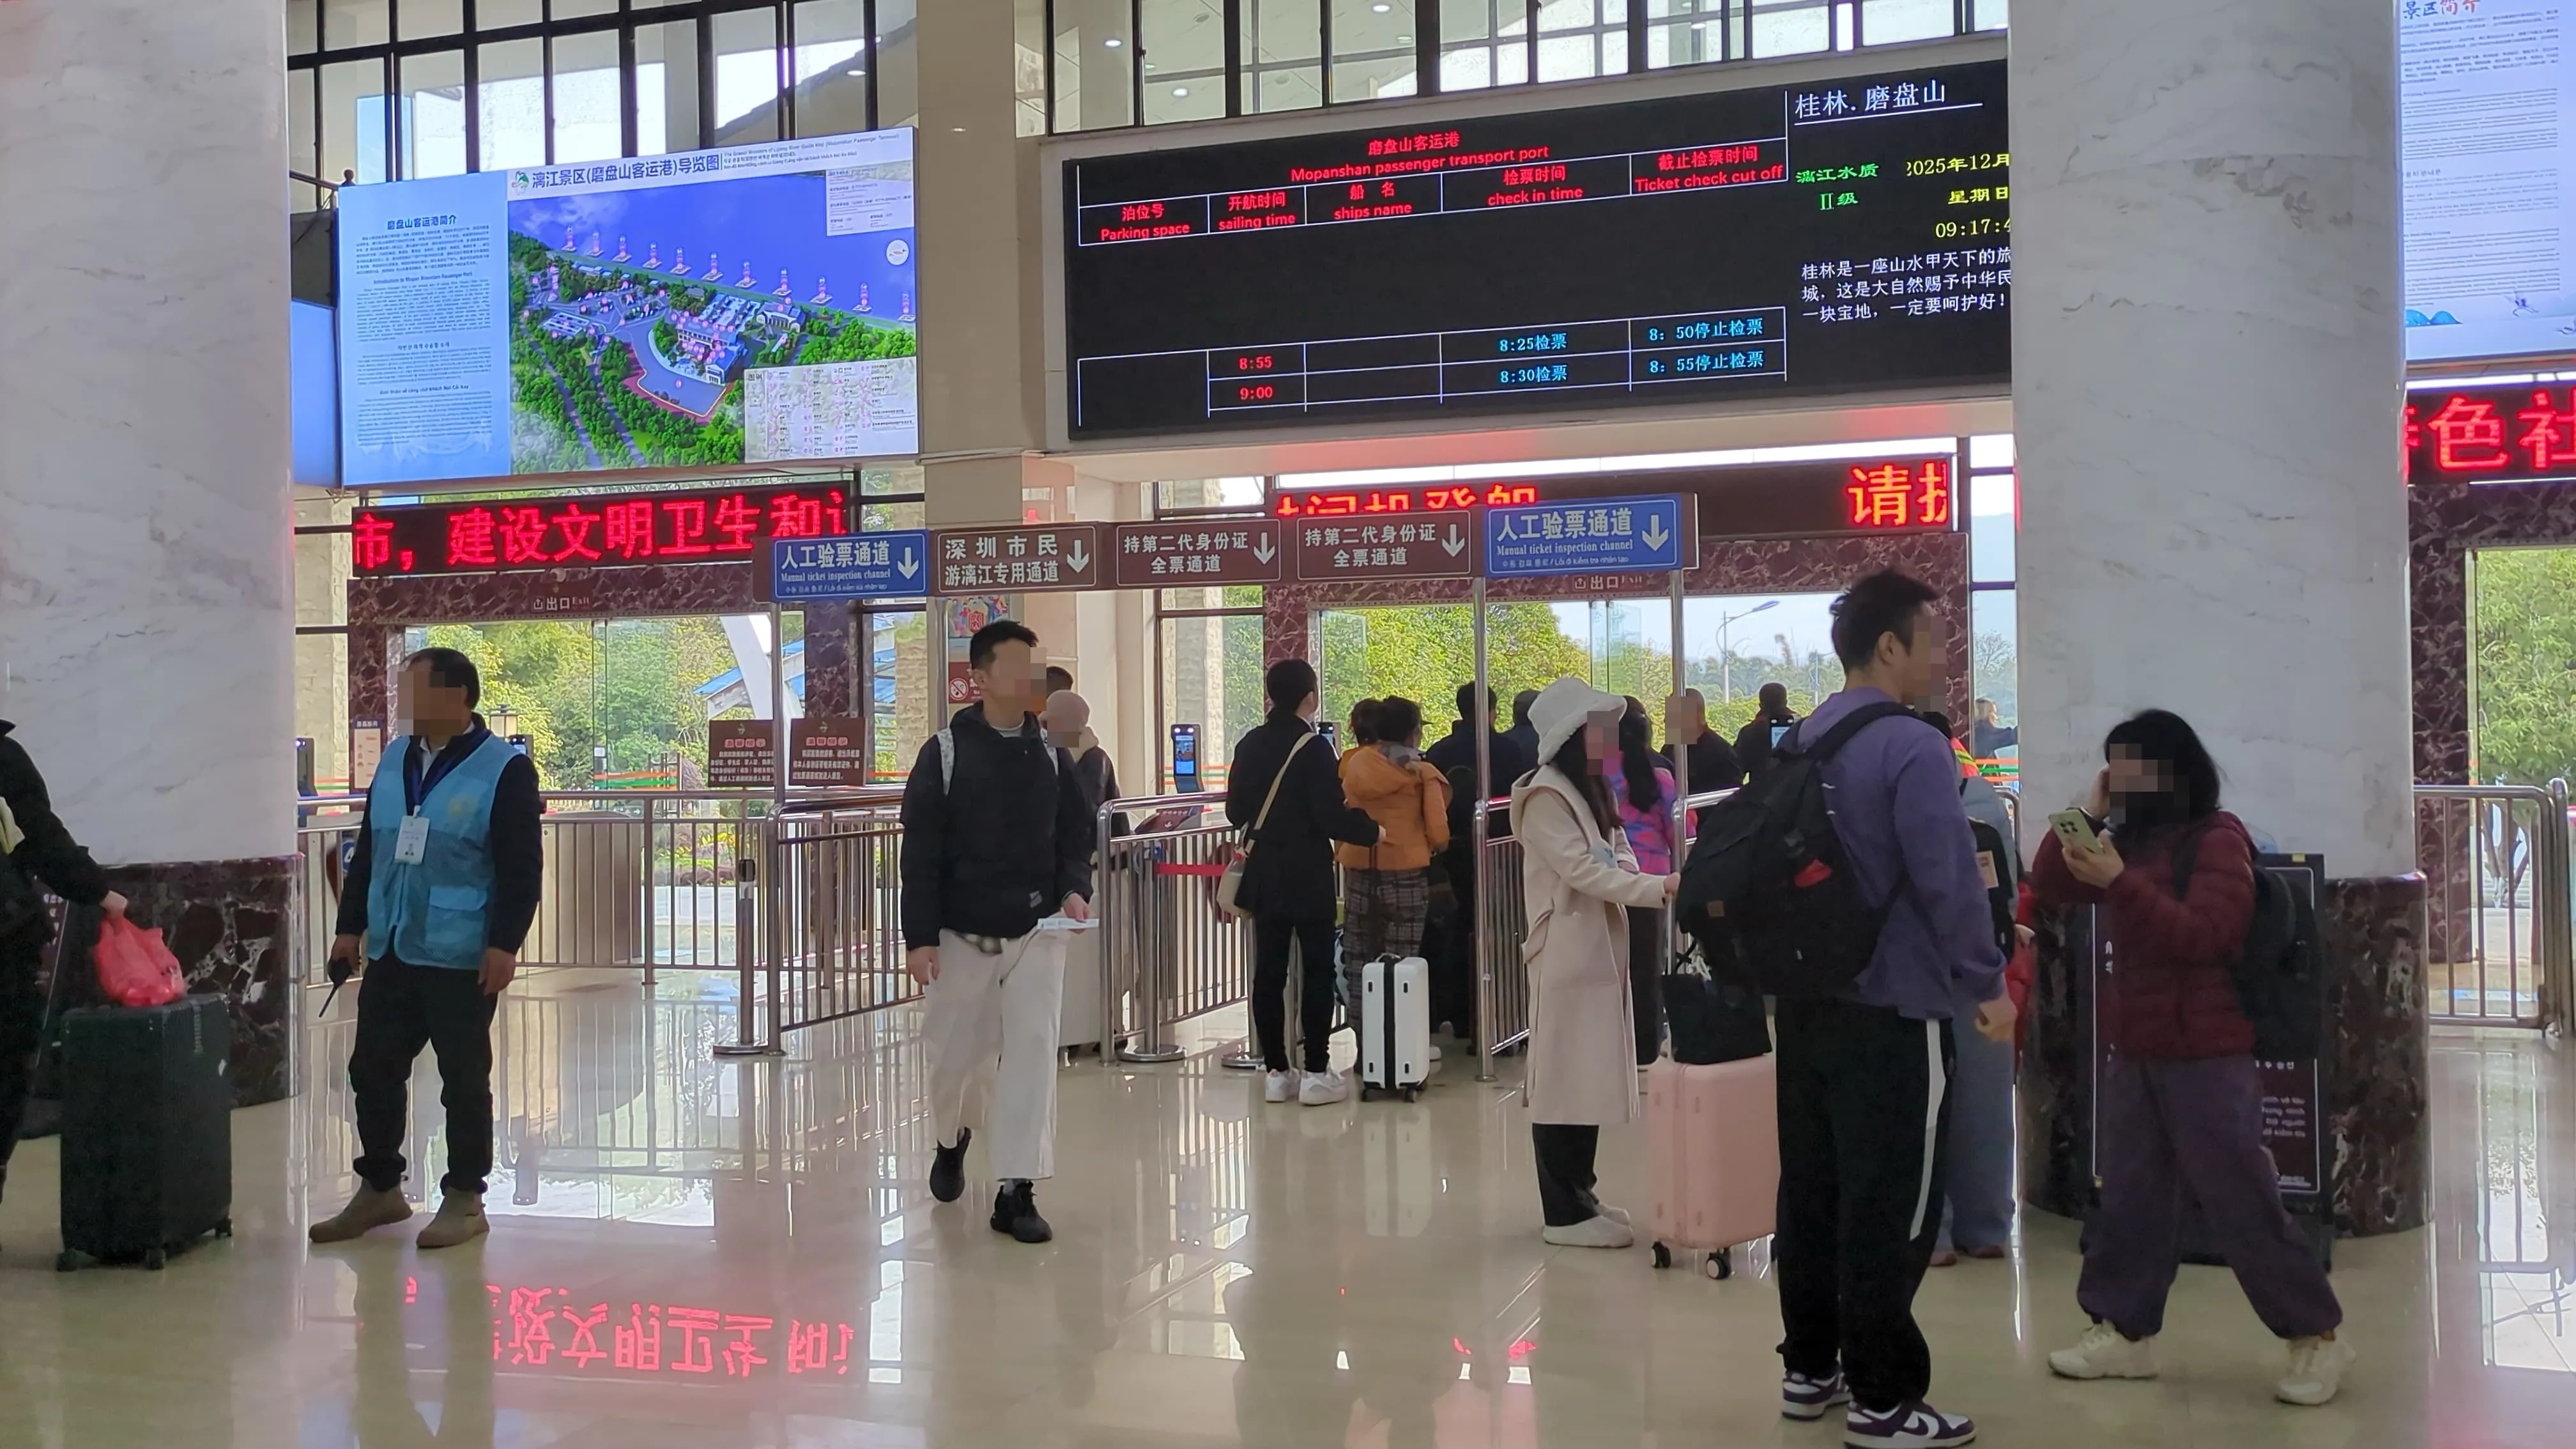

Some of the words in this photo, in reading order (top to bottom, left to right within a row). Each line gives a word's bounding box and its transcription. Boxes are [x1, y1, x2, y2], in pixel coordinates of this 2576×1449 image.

[1368, 132, 1460, 157] 磨盘山客运港
[1291, 164, 1371, 182] Mopanshan
[1374, 158, 1446, 177] passenger
[1449, 148, 1516, 167] transport
[1519, 145, 1549, 162] port
[1657, 146, 1759, 171] 截止检票时间
[532, 154, 720, 189] 漓江景区(磨盘山客运港)导览图
[1503, 165, 1567, 185] 检票时间
[1634, 176, 1681, 192] Ticket
[1683, 172, 1728, 189] check
[1731, 169, 1756, 184] cut
[1759, 165, 1784, 180] off
[1795, 162, 1880, 184] 漓江水质
[1381, 181, 1395, 197] 名
[1487, 190, 1531, 206] check
[1533, 189, 1547, 203] in
[1550, 187, 1583, 201] time
[1947, 186, 2009, 205] 星期日
[1228, 192, 1286, 211] 开航时间
[1333, 206, 1370, 220] ships
[1374, 203, 1412, 215] name
[1121, 204, 1165, 222] 泊位号
[1218, 215, 1261, 231] sailing
[1265, 213, 1296, 226] time
[1101, 225, 1149, 241] Parking
[1153, 224, 1190, 238] space
[1802, 247, 2011, 280] 桂林是一座山水甲天下的旅
[1802, 293, 2005, 323] 一块宝地，一定要呵护好！
[1499, 332, 1568, 352] 8:25检票
[1238, 355, 1273, 370] 8:55
[1499, 364, 1568, 383] 8:30检票
[1239, 386, 1274, 400] 9:00
[1496, 507, 1633, 542] 人工验票通道
[1124, 532, 1249, 554] 持第二代身份证
[1305, 523, 1437, 547] 持第二代身份证
[781, 540, 891, 570] 人工验票通道
[945, 534, 1059, 560] 深圳市民
[1497, 544, 1527, 556] Manual
[1529, 544, 1552, 555] ticket
[1554, 541, 1597, 555] inspection
[1600, 539, 1633, 551] channel
[1151, 555, 1222, 574] 全票通道
[1333, 547, 1407, 568] 全票通道
[781, 572, 806, 582] Manual
[808, 571, 826, 581] ticket
[828, 569, 862, 582] inspection
[864, 568, 891, 579] channel
[944, 560, 1059, 587] 游漓江专用通道
[1591, 575, 1619, 590] 出口
[546, 596, 570, 611] 出口
